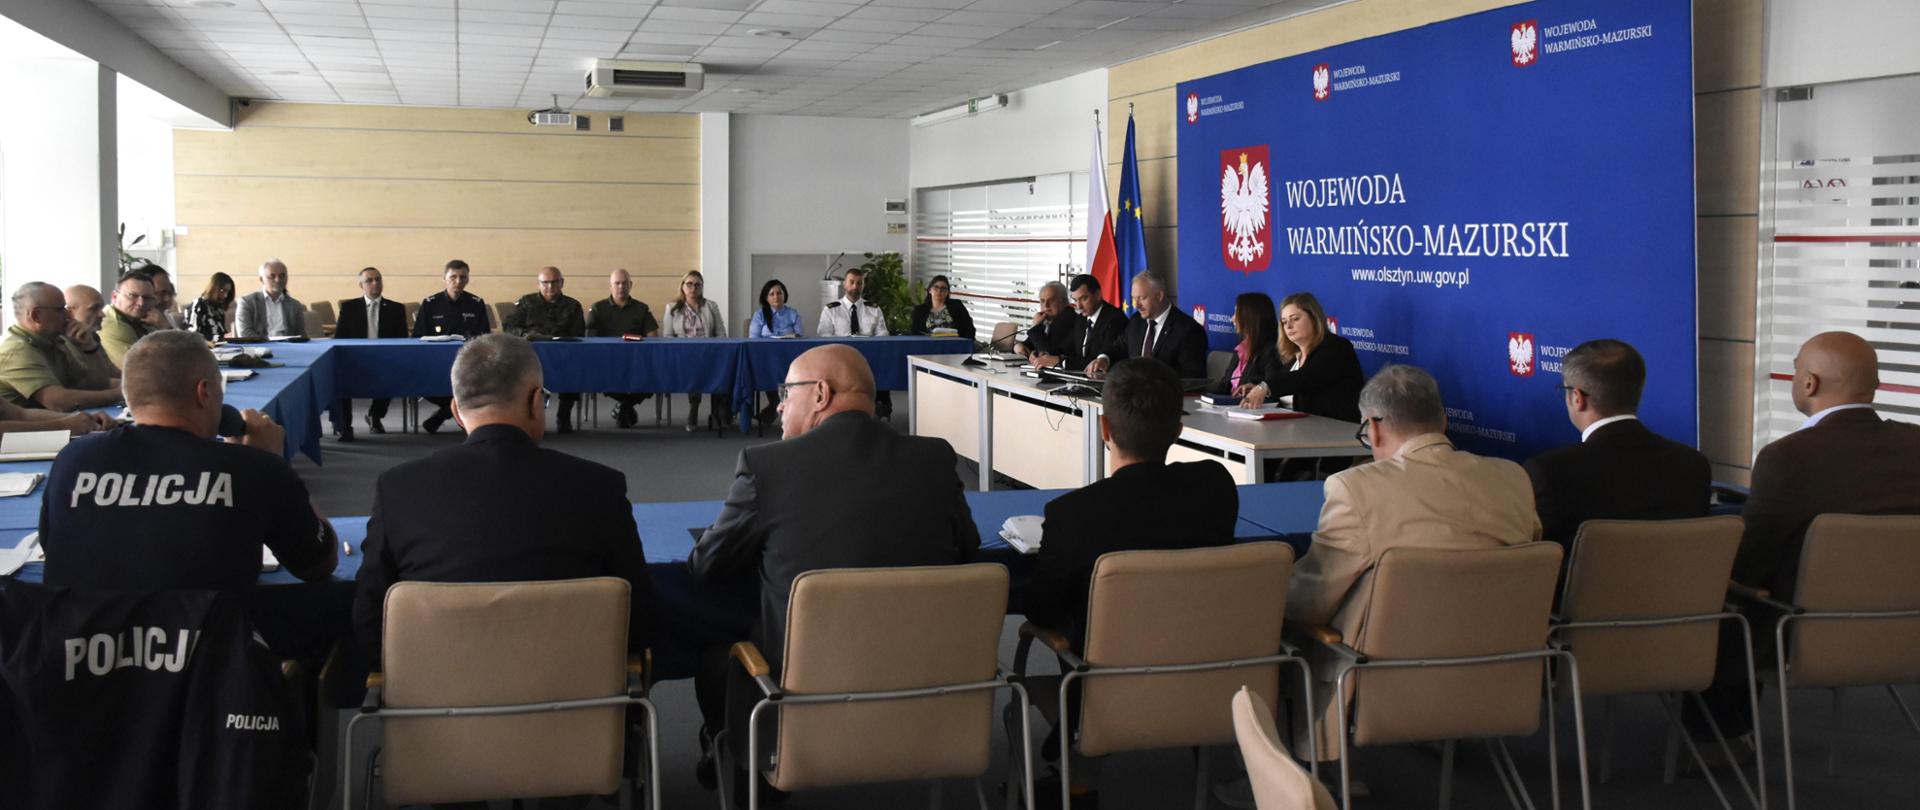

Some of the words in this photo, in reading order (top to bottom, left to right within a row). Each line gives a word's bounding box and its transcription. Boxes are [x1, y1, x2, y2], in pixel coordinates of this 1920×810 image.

[1544, 19, 1597, 38] WOJEWODA
[1544, 25, 1653, 54] WARMIŃSKO-MAZURSKI
[1333, 65, 1366, 79] WOJEWODA
[1286, 173, 1406, 208] WOJEWODA
[1286, 219, 1569, 258] WARMIŃSKO-MAZURSKI
[1351, 267, 1470, 289] www.olsztyn.uw.gov.pl
[70, 471, 234, 508] POLICJA
[64, 626, 202, 681] POLICJ
[226, 714, 280, 731] POLICJA
